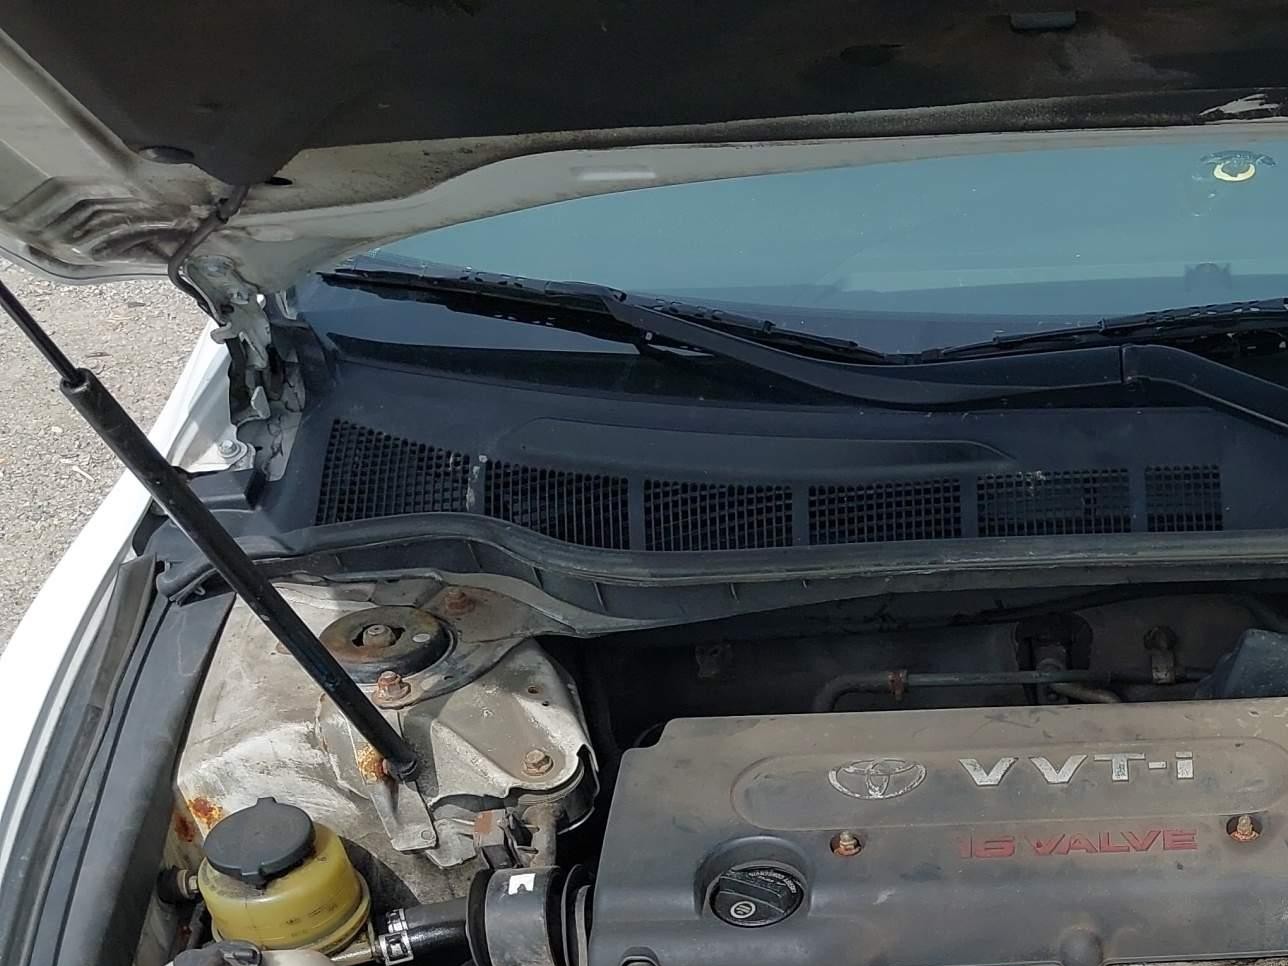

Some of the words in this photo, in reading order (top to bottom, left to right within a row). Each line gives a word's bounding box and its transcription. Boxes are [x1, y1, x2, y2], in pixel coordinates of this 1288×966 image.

[959, 752, 1195, 787] VVT-i
[959, 836, 1016, 859] 16
[1024, 829, 1197, 855] VALVE
